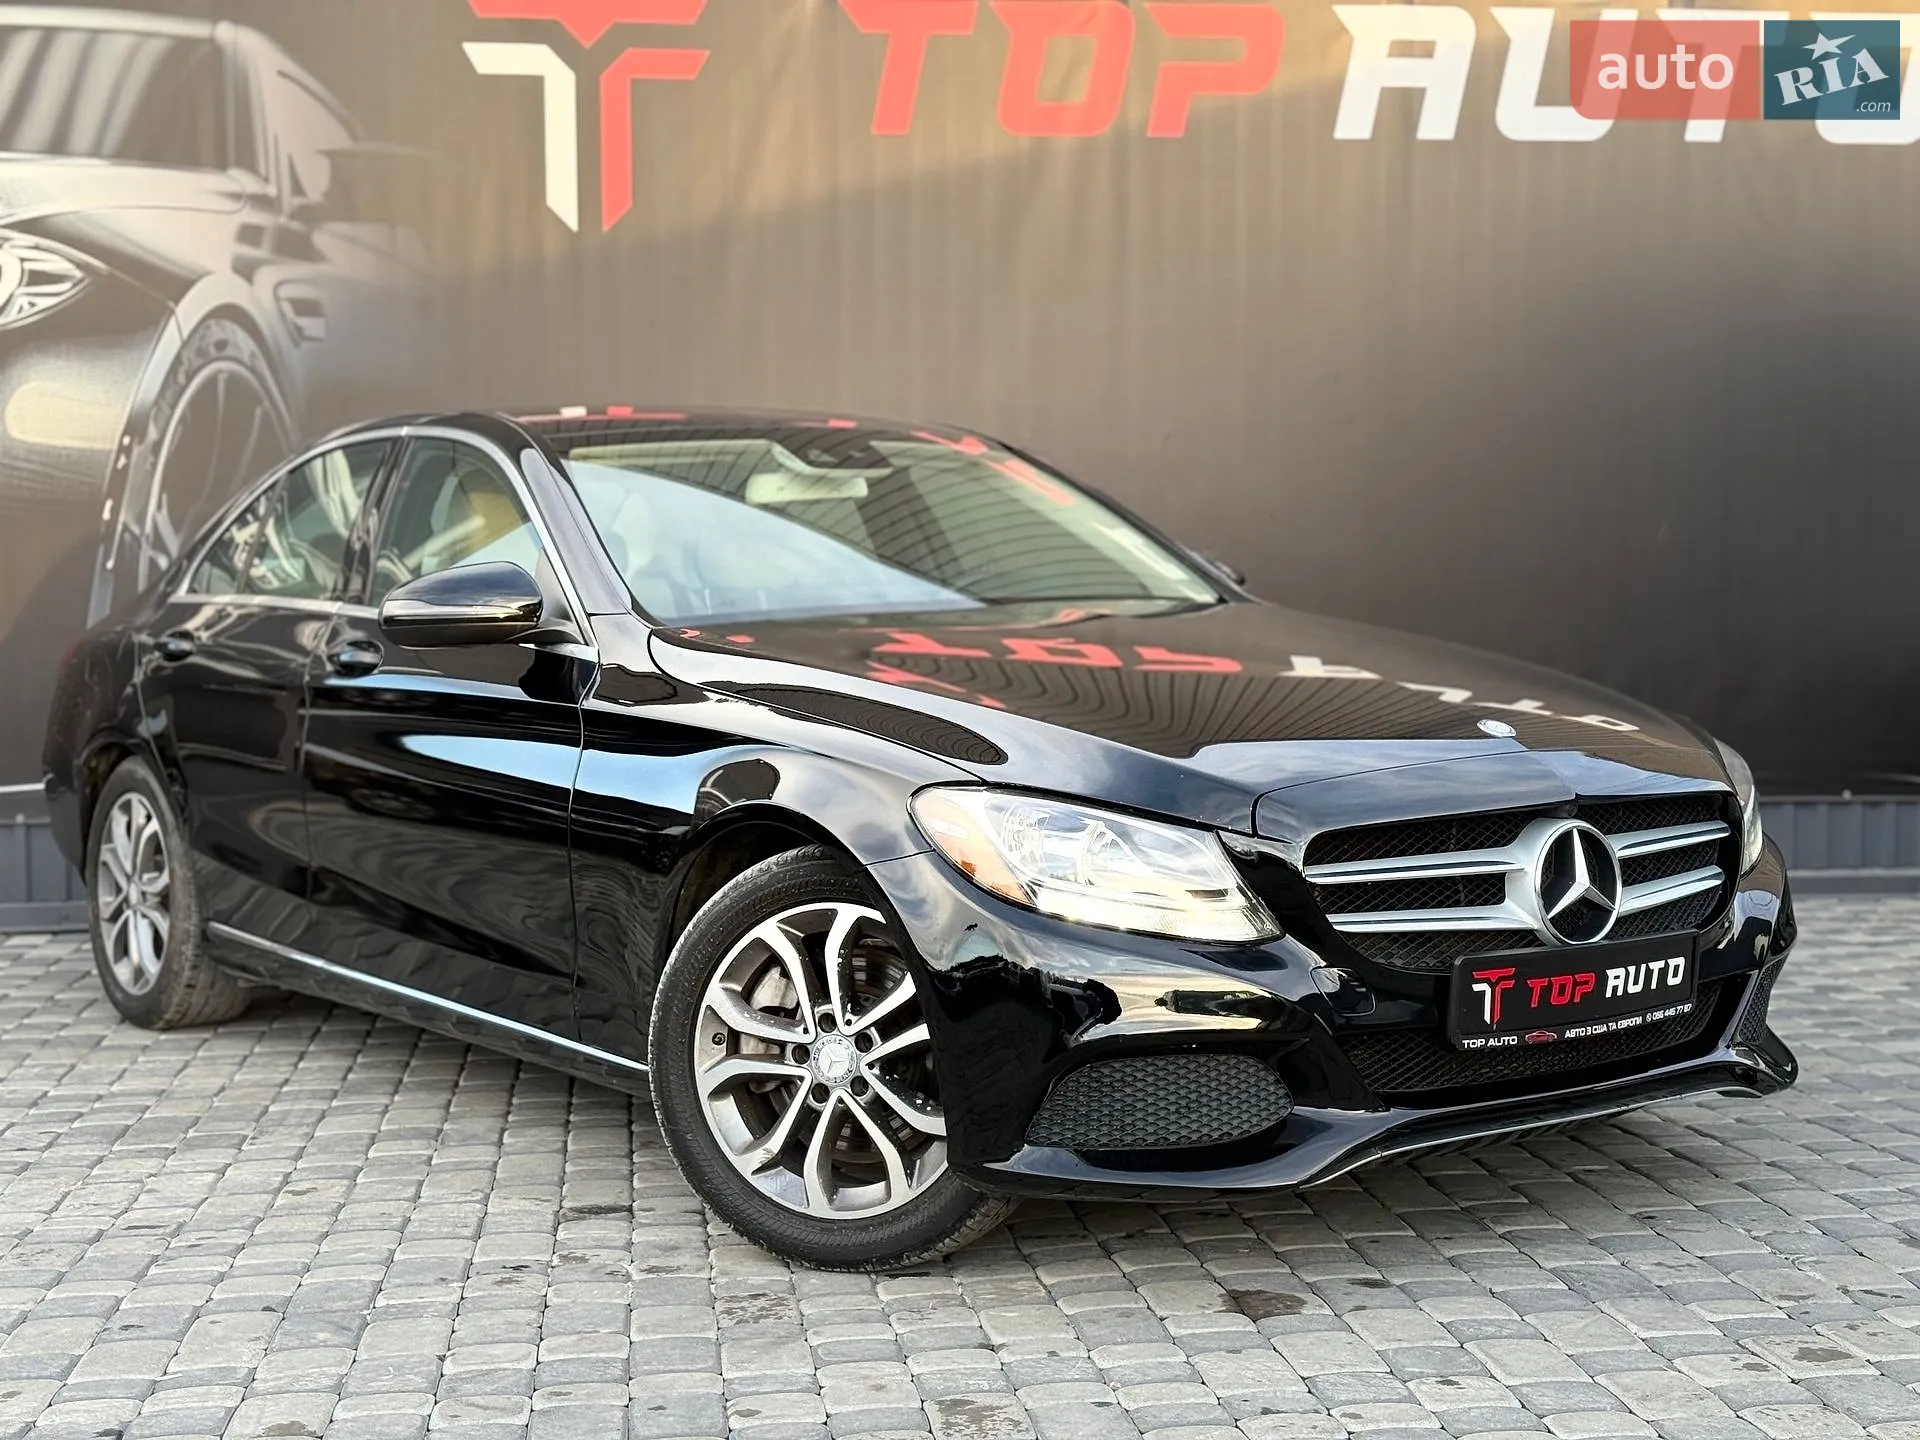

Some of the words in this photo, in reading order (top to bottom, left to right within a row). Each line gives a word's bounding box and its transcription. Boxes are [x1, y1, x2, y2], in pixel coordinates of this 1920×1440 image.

[837, 0, 1285, 137] TOP
[1526, 972, 1597, 1008] TOP
[1605, 956, 1686, 998] AUTO
[1462, 1039, 1486, 1049] TOP
[1487, 1036, 1518, 1047] AUTO
